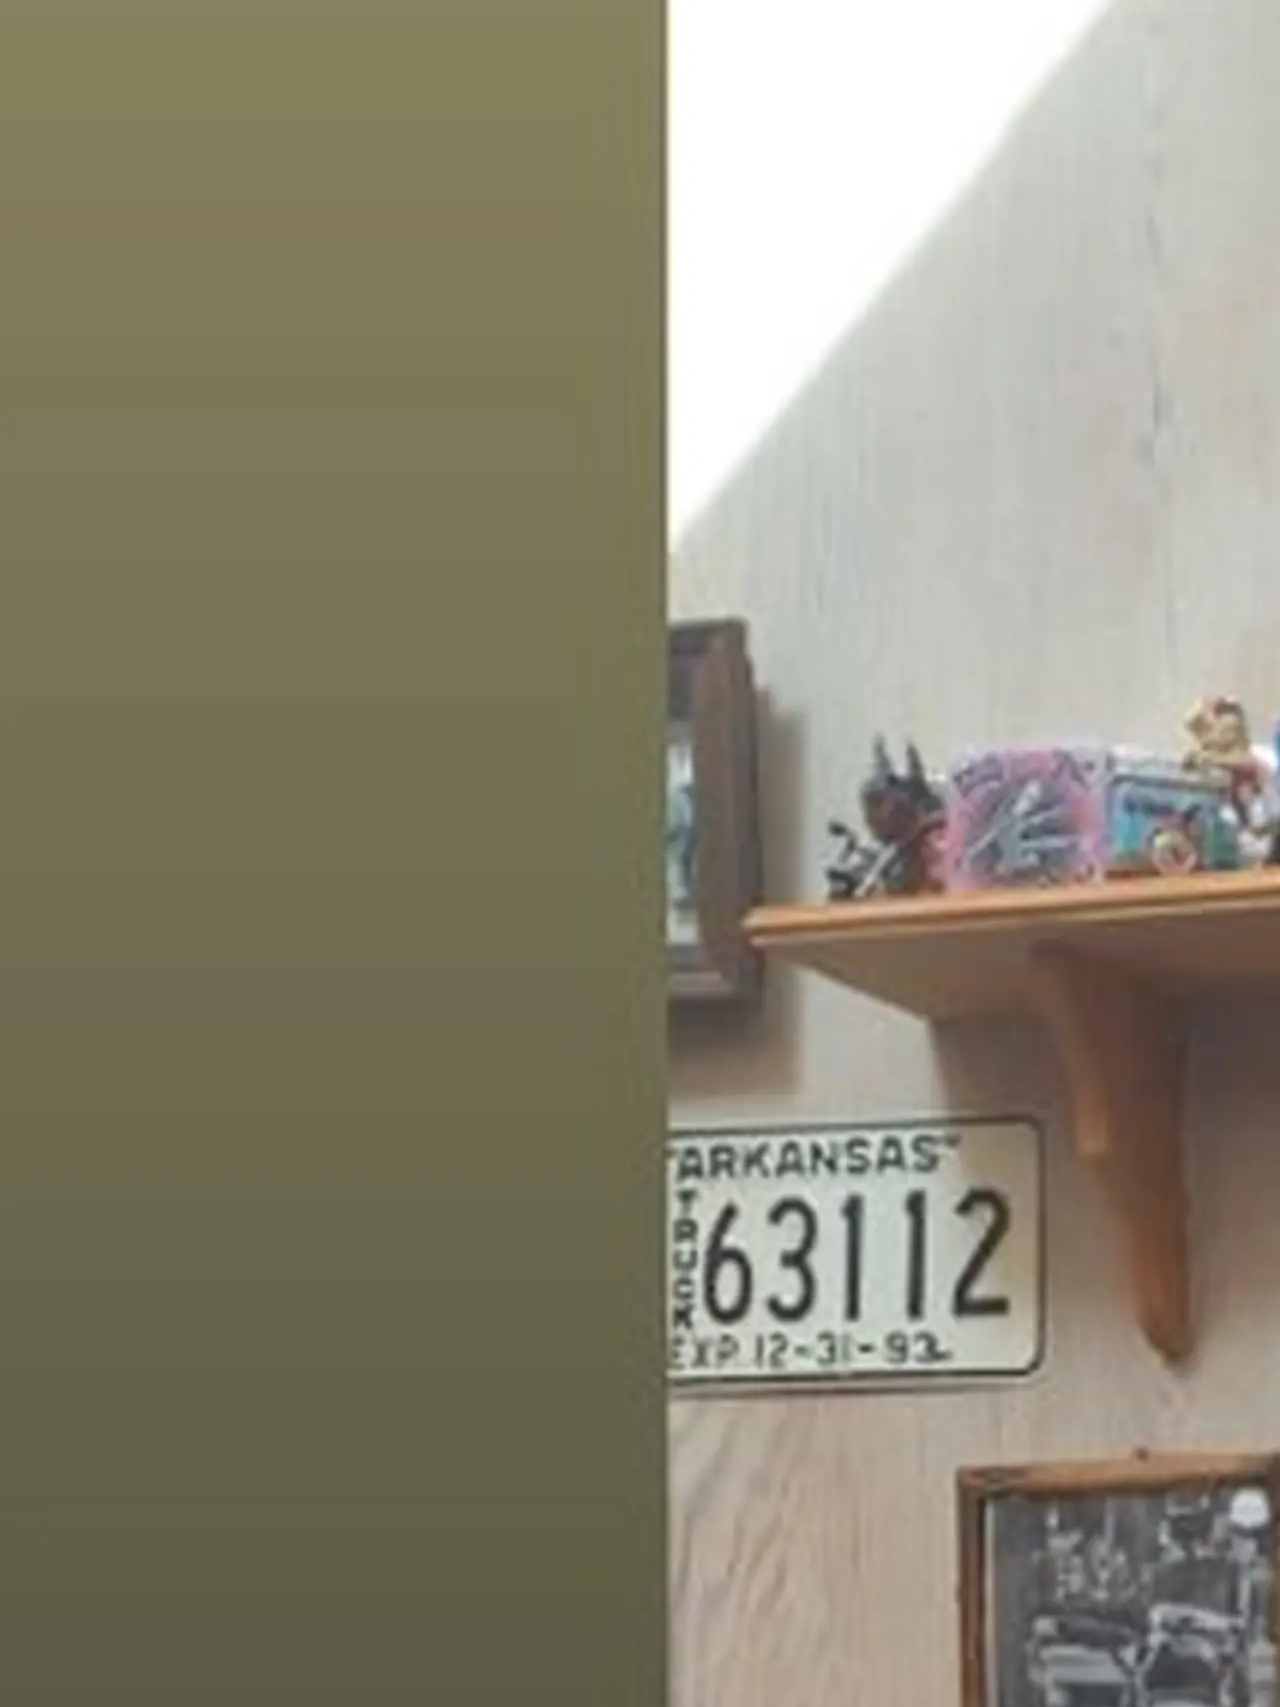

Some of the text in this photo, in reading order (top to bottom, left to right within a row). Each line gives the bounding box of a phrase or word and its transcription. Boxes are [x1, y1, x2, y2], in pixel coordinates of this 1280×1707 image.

[676, 1133, 940, 1180] ARKANSAS
[673, 1189, 699, 1329] TRUCK
[704, 1187, 1013, 1327] 63112
